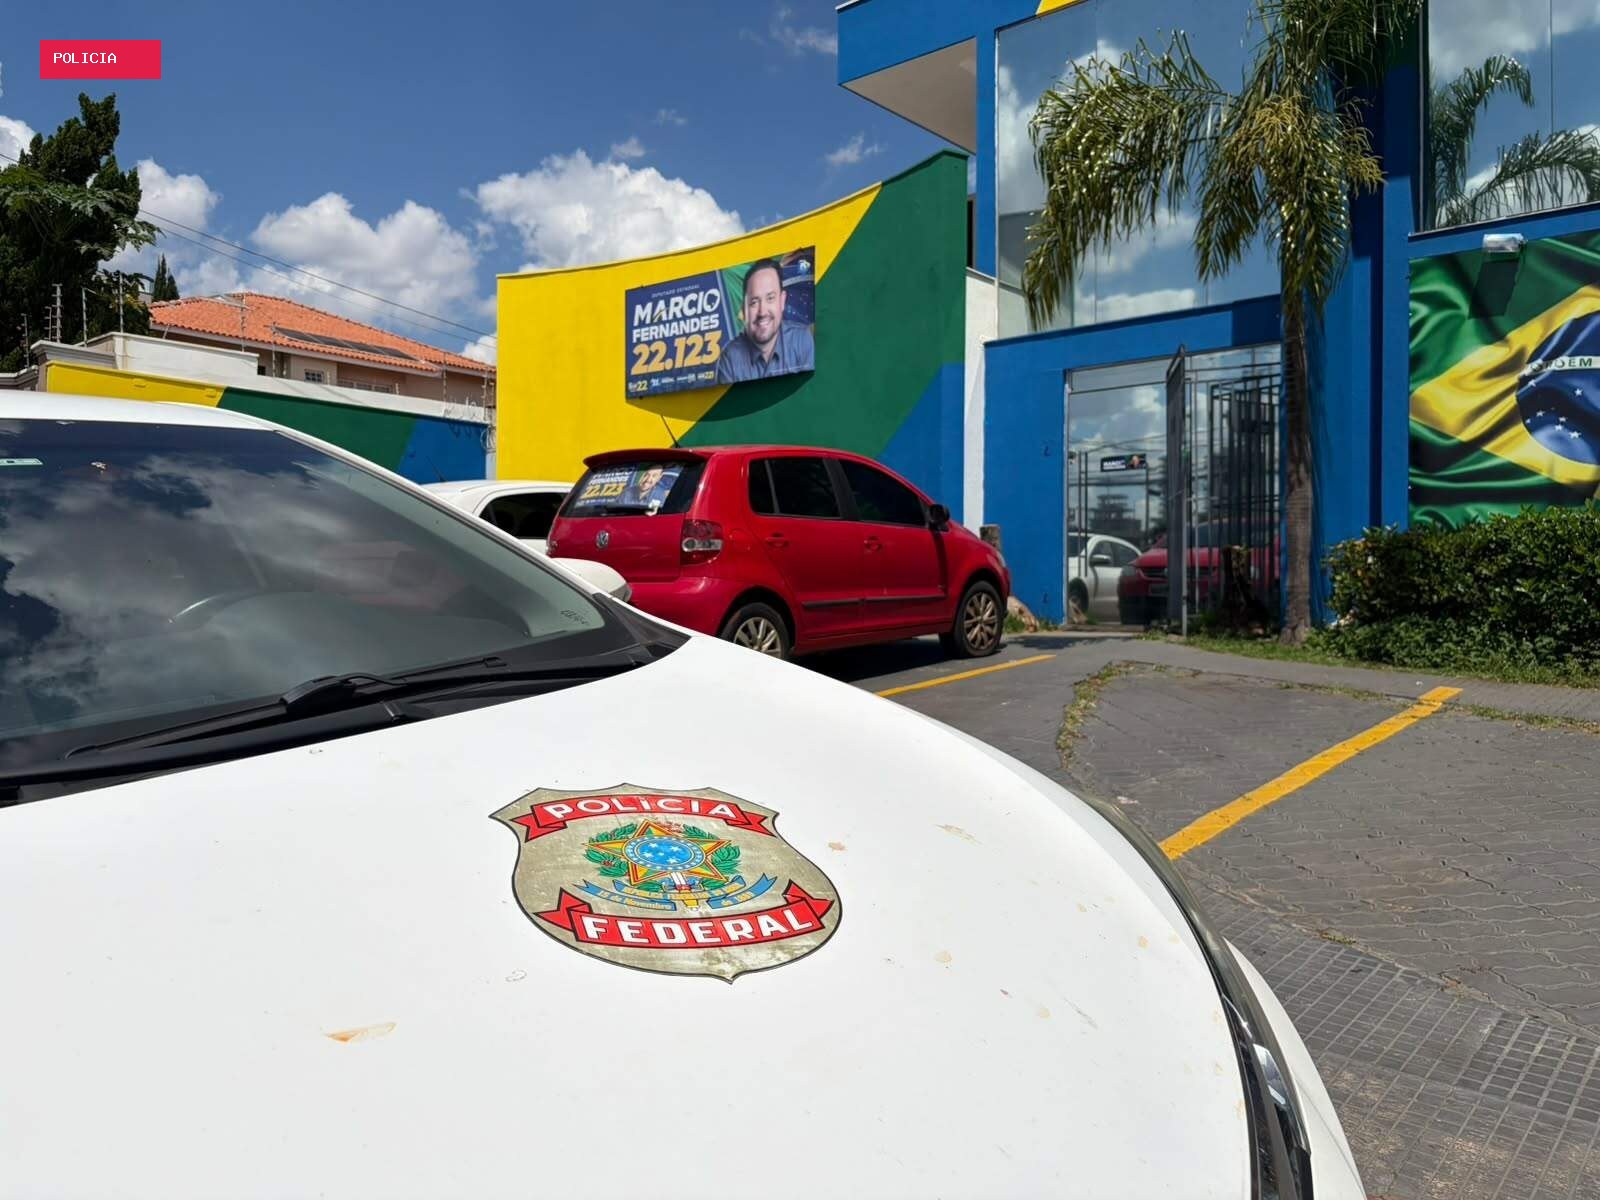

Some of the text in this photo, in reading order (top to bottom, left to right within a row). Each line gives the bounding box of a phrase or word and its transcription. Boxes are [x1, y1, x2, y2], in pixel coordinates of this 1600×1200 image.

[633, 288, 720, 326] MARCIO
[632, 314, 720, 343] FERNANDES
[630, 331, 722, 376] 22.123
[581, 909, 813, 944] FEDERAL
